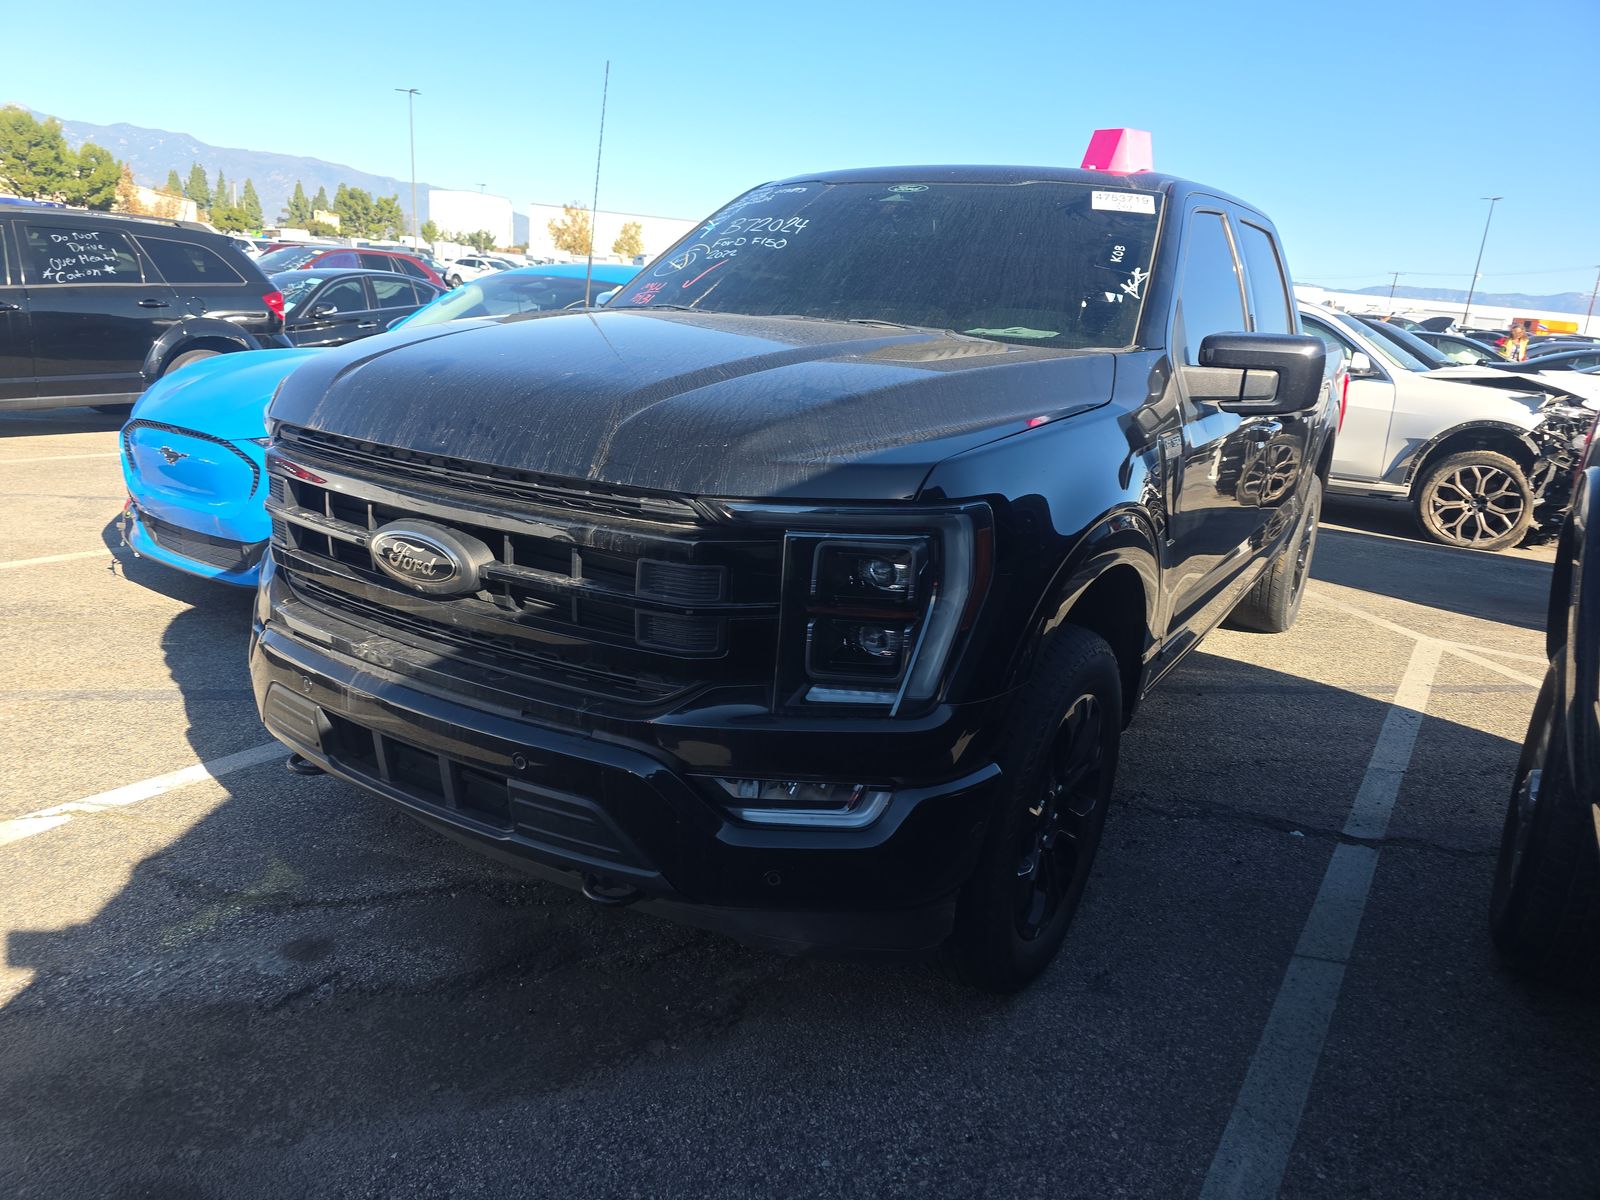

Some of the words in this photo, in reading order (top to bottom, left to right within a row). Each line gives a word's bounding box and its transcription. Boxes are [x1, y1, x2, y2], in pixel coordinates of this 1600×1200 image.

[50, 234, 69, 243] Do
[72, 232, 99, 240] NOT
[752, 237, 787, 249] F150
[66, 242, 105, 253] Drive
[389, 541, 437, 576] Ford
